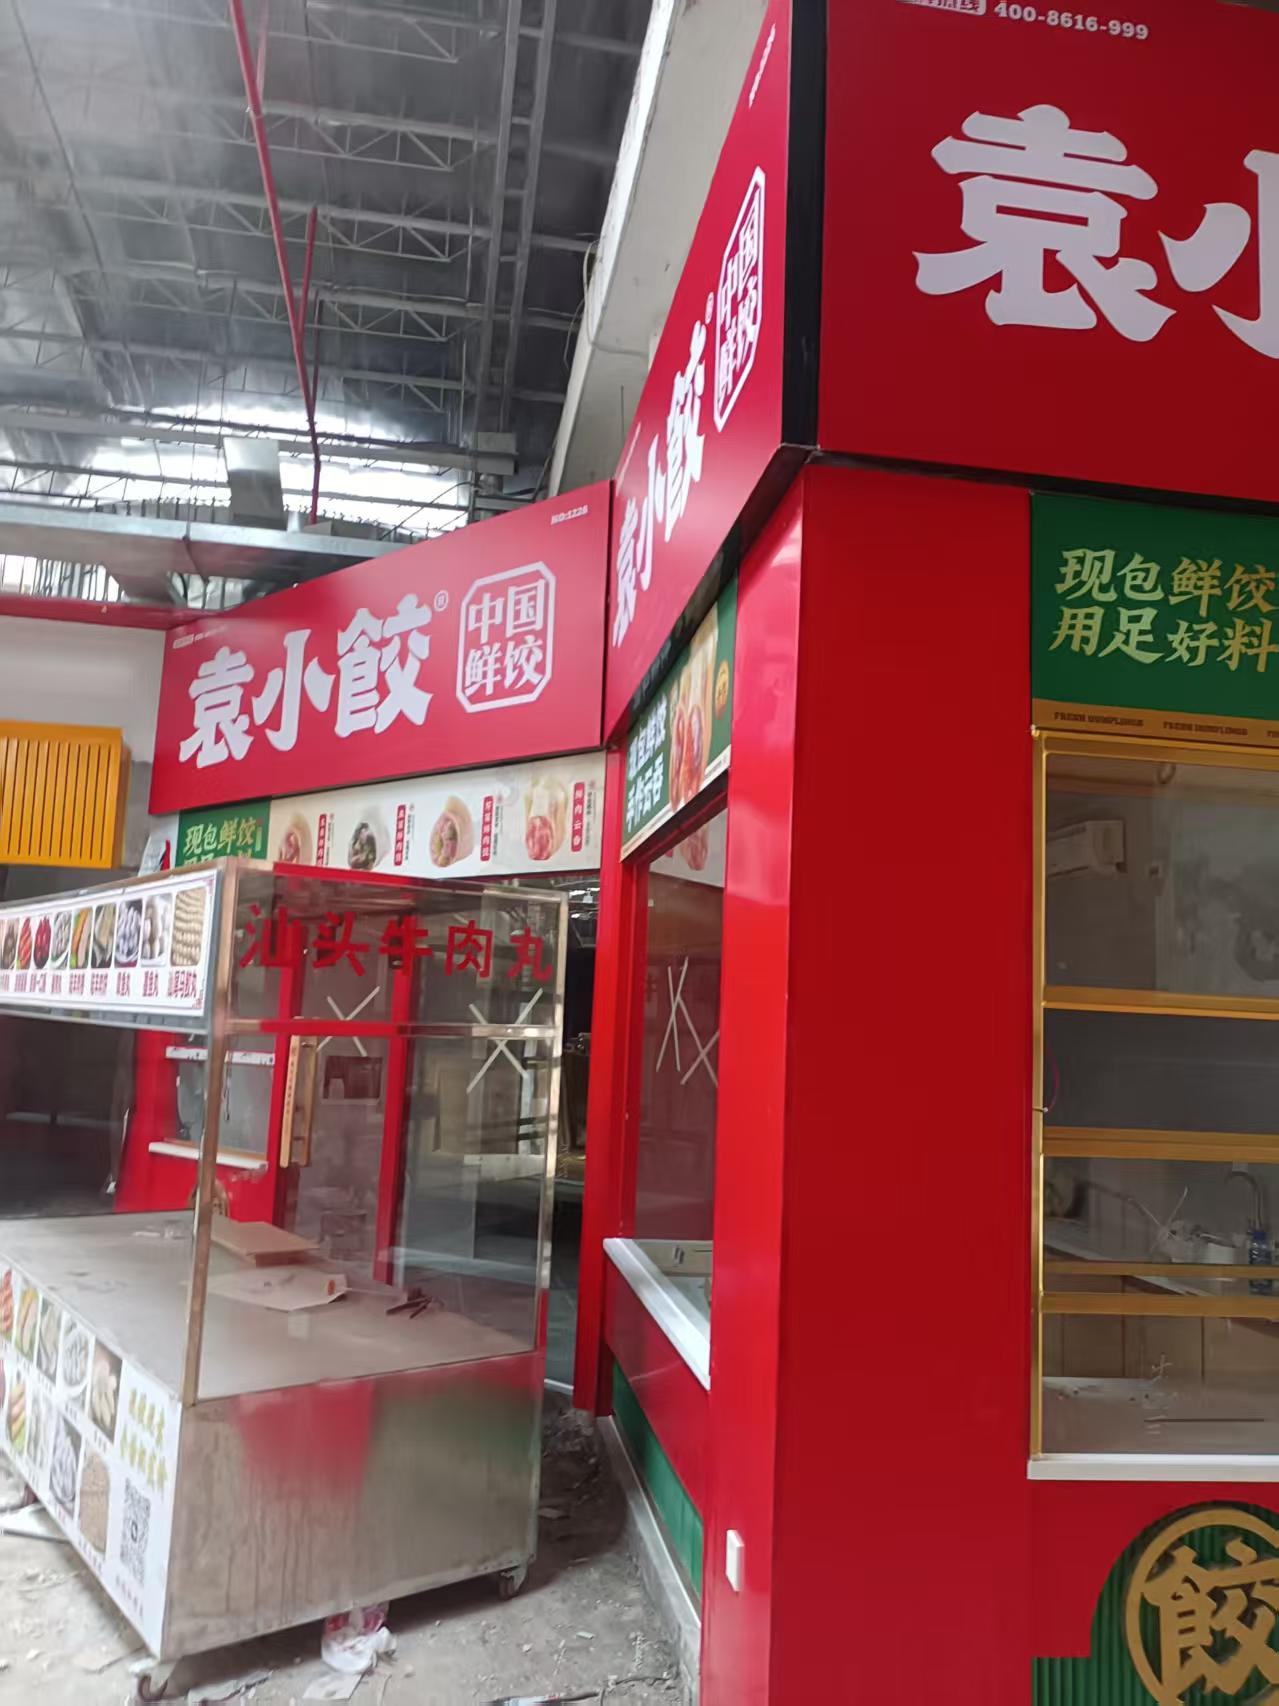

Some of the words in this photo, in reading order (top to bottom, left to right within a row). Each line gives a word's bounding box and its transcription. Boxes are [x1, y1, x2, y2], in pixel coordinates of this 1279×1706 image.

[994, 2, 1149, 40] 400-8616-999
[720, 187, 760, 331] 中国
[718, 275, 758, 412] 鲜饺
[467, 578, 546, 644] 中国
[1054, 548, 1279, 618] 现包鲜饺
[464, 635, 544, 697] 鲜饺
[1048, 605, 1279, 672] 用足好料
[183, 817, 256, 857] 现包鲜饺
[239, 904, 553, 982] 汕头牛肉丸
